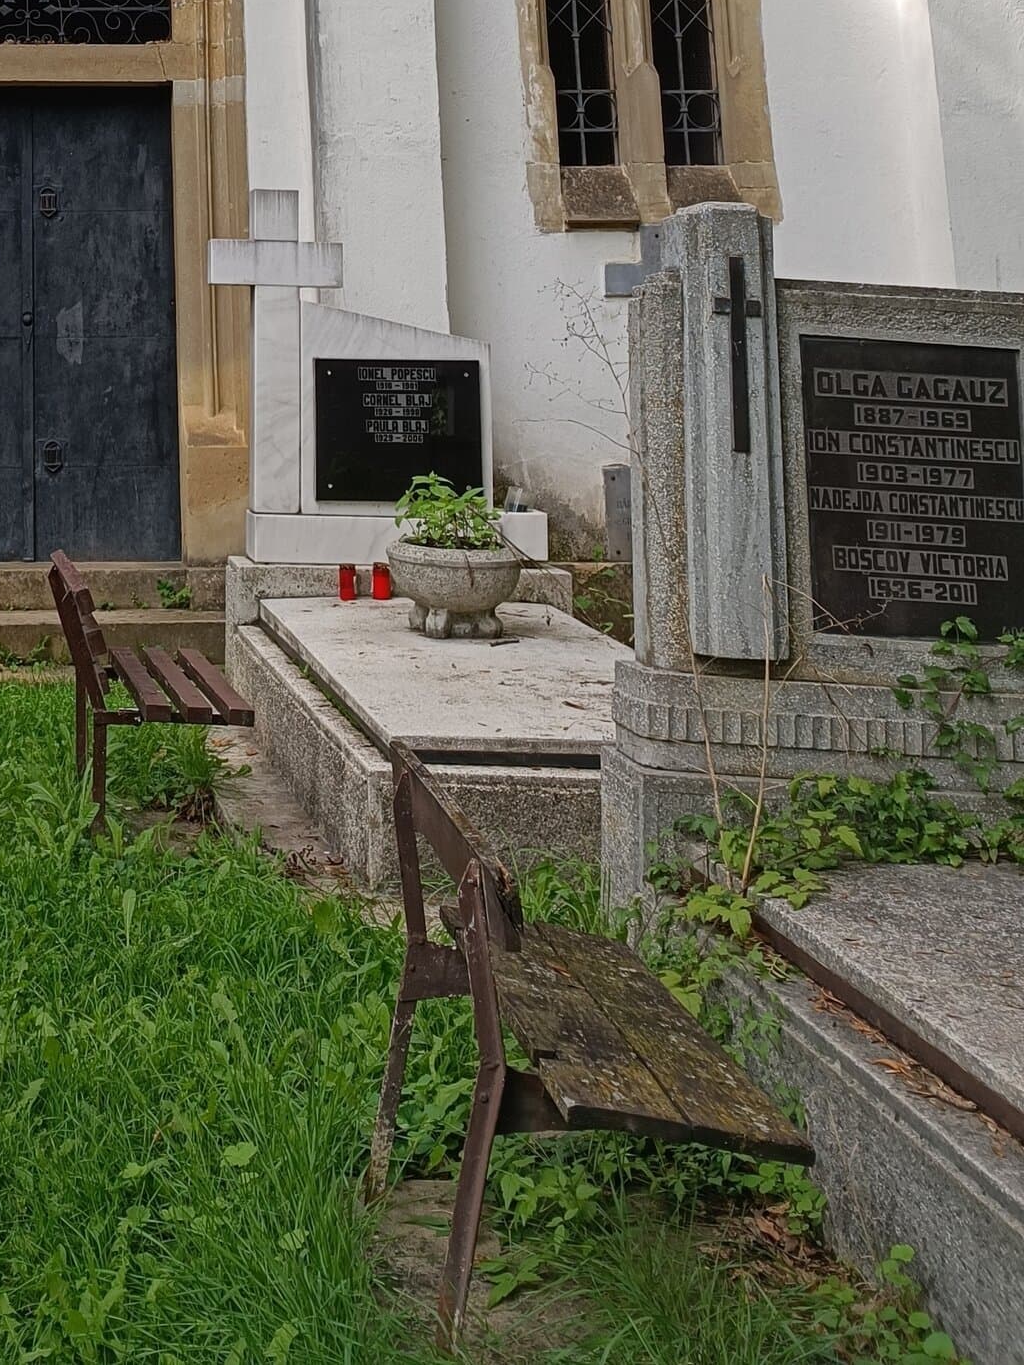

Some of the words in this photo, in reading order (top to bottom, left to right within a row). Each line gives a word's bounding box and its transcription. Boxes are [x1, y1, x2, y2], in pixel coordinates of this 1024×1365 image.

[359, 368, 387, 380] IONEL
[391, 368, 435, 381] POPESCU
[364, 394, 402, 406] CORNEL
[406, 394, 431, 406] BLAJ
[817, 371, 888, 398] OLGA
[896, 376, 1005, 404] GAGAUZ
[367, 420, 398, 432] PAULA
[402, 420, 428, 433] BLAJ
[857, 407, 968, 429] 1887-1969
[809, 430, 839, 452] ION
[849, 433, 1018, 462] CONSTANTINESCU
[860, 463, 971, 488] 1903-1977
[810, 487, 884, 513] NADEJDA
[889, 492, 1024, 521] CONSTANTINESCU
[869, 520, 964, 546] 1911-1979
[919, 552, 1007, 579] VICTORIA
